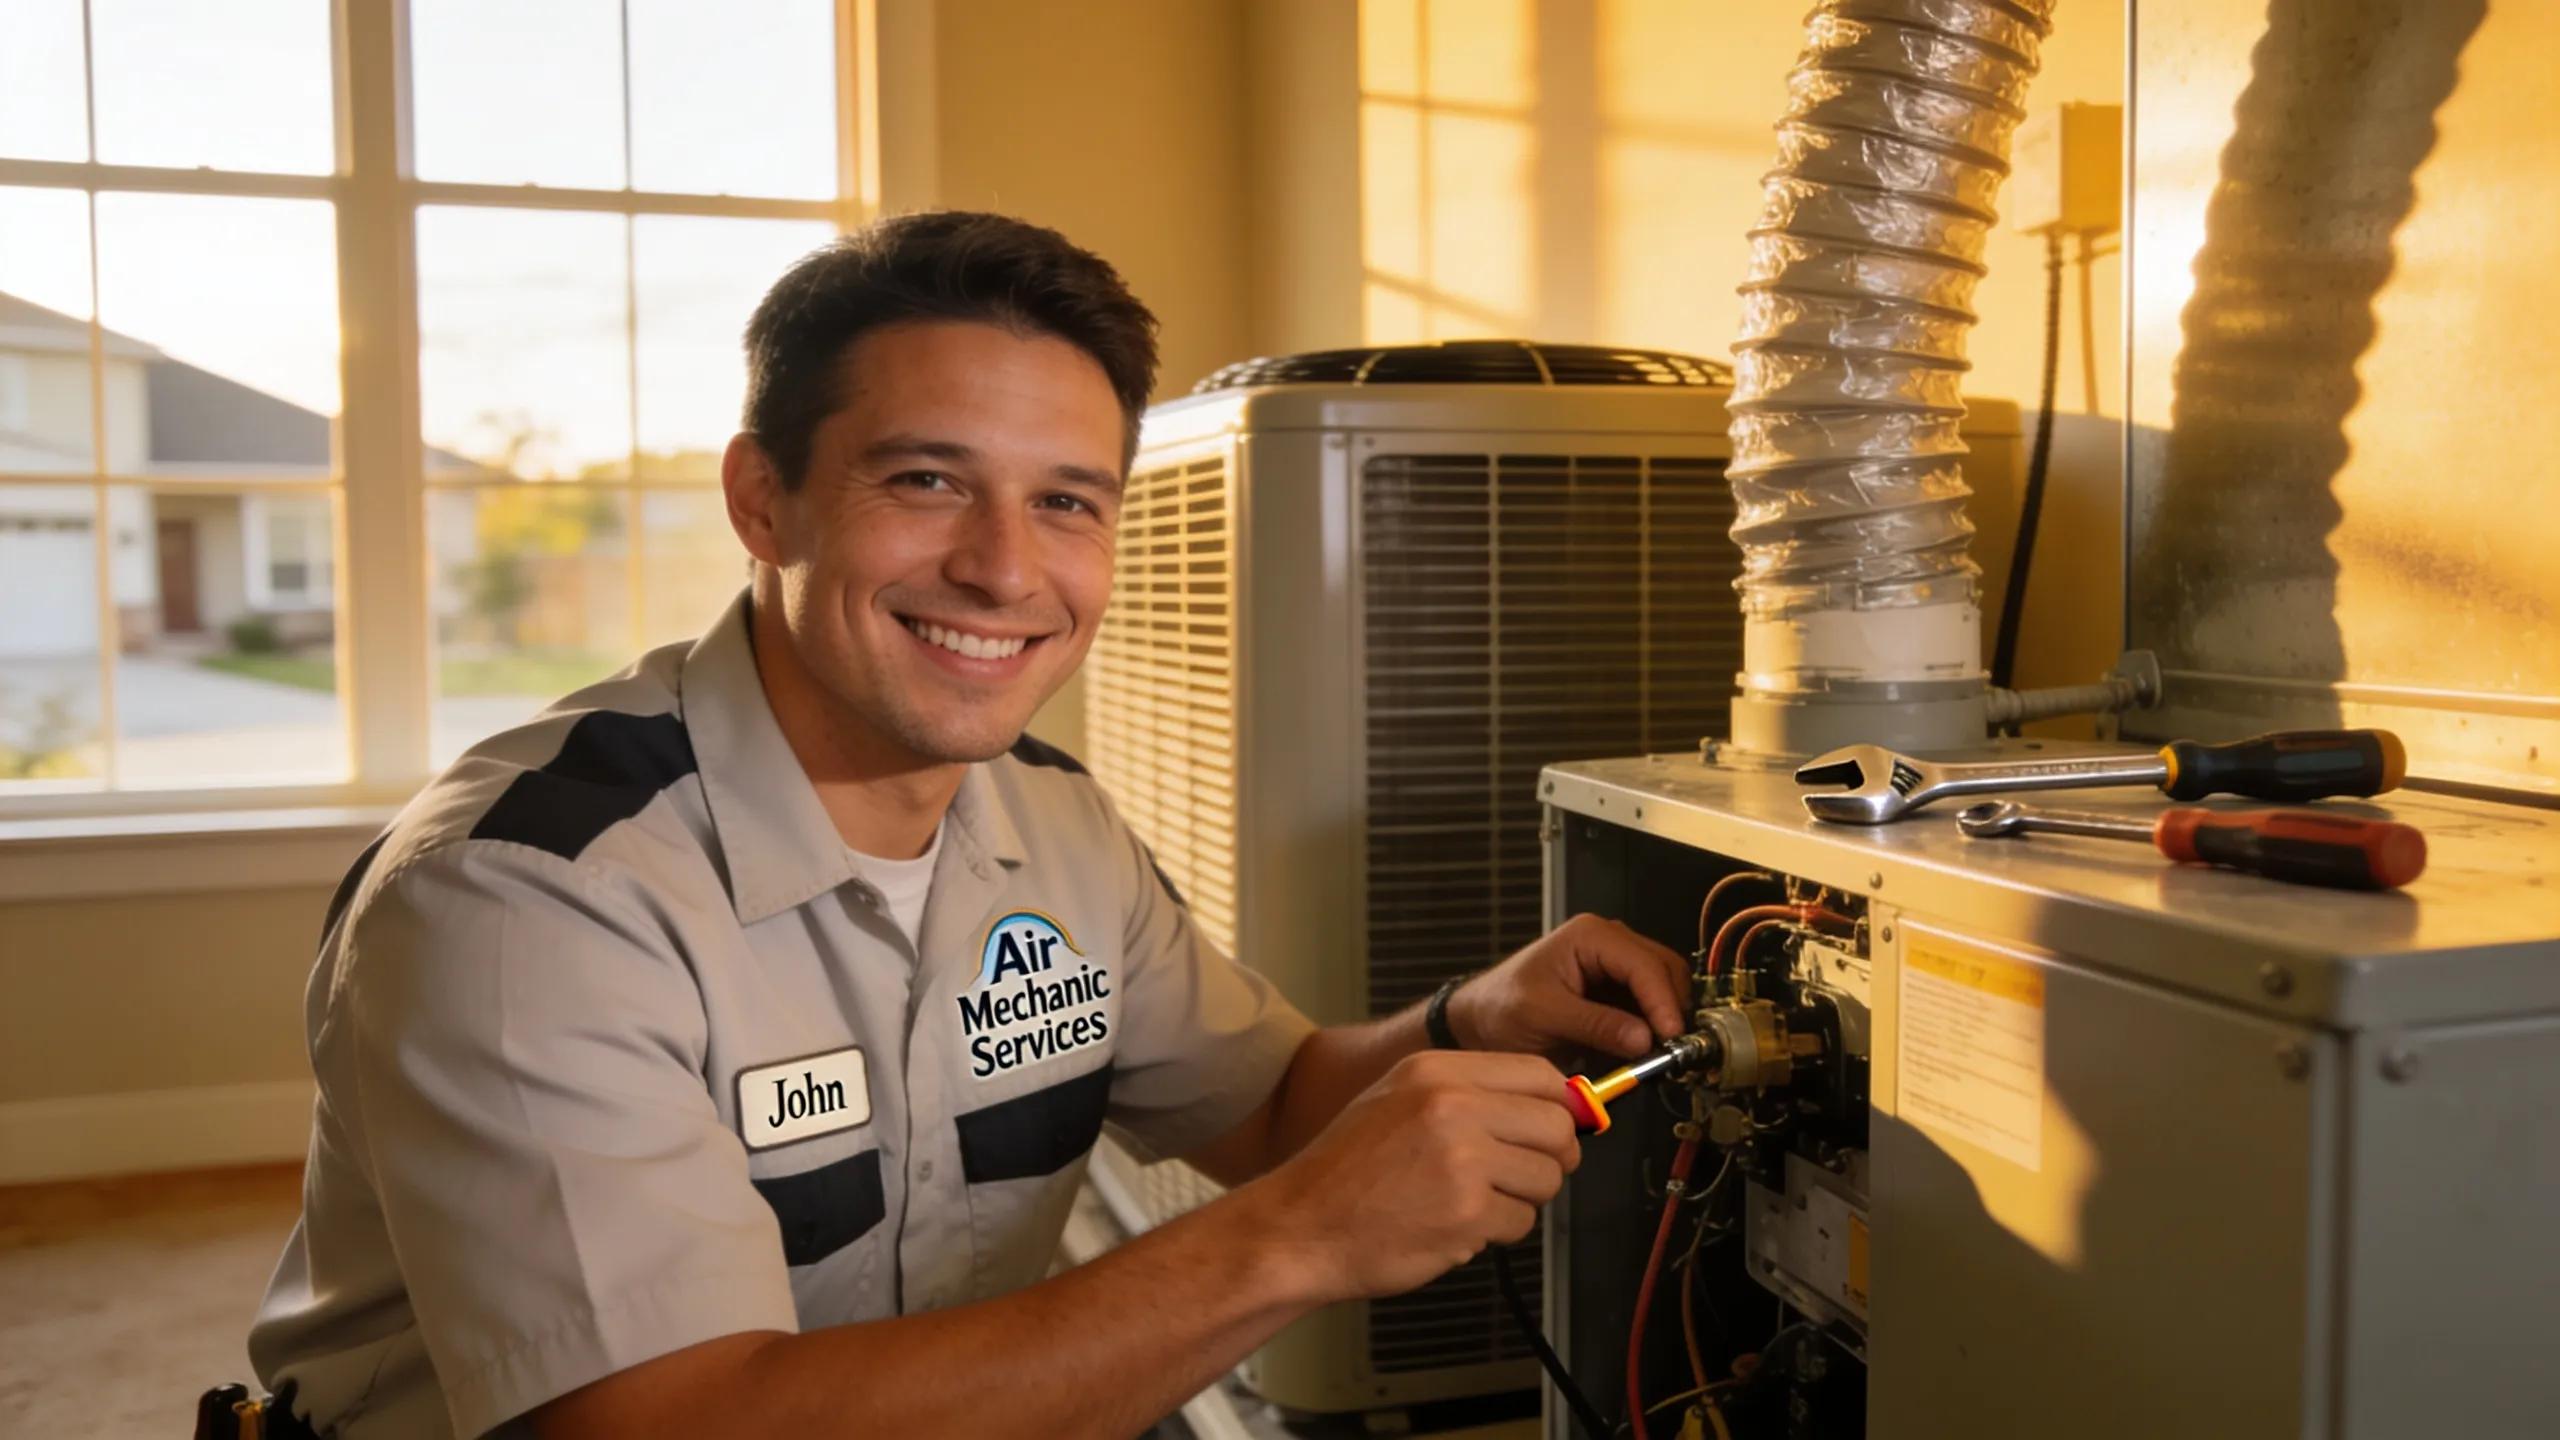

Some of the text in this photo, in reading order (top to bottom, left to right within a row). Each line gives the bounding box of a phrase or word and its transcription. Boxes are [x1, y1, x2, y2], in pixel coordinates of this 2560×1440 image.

[990, 930, 1058, 984] Air
[957, 963, 1111, 1036] Mechanic
[970, 1010, 1108, 1077] Services
[768, 1071, 848, 1129] John
